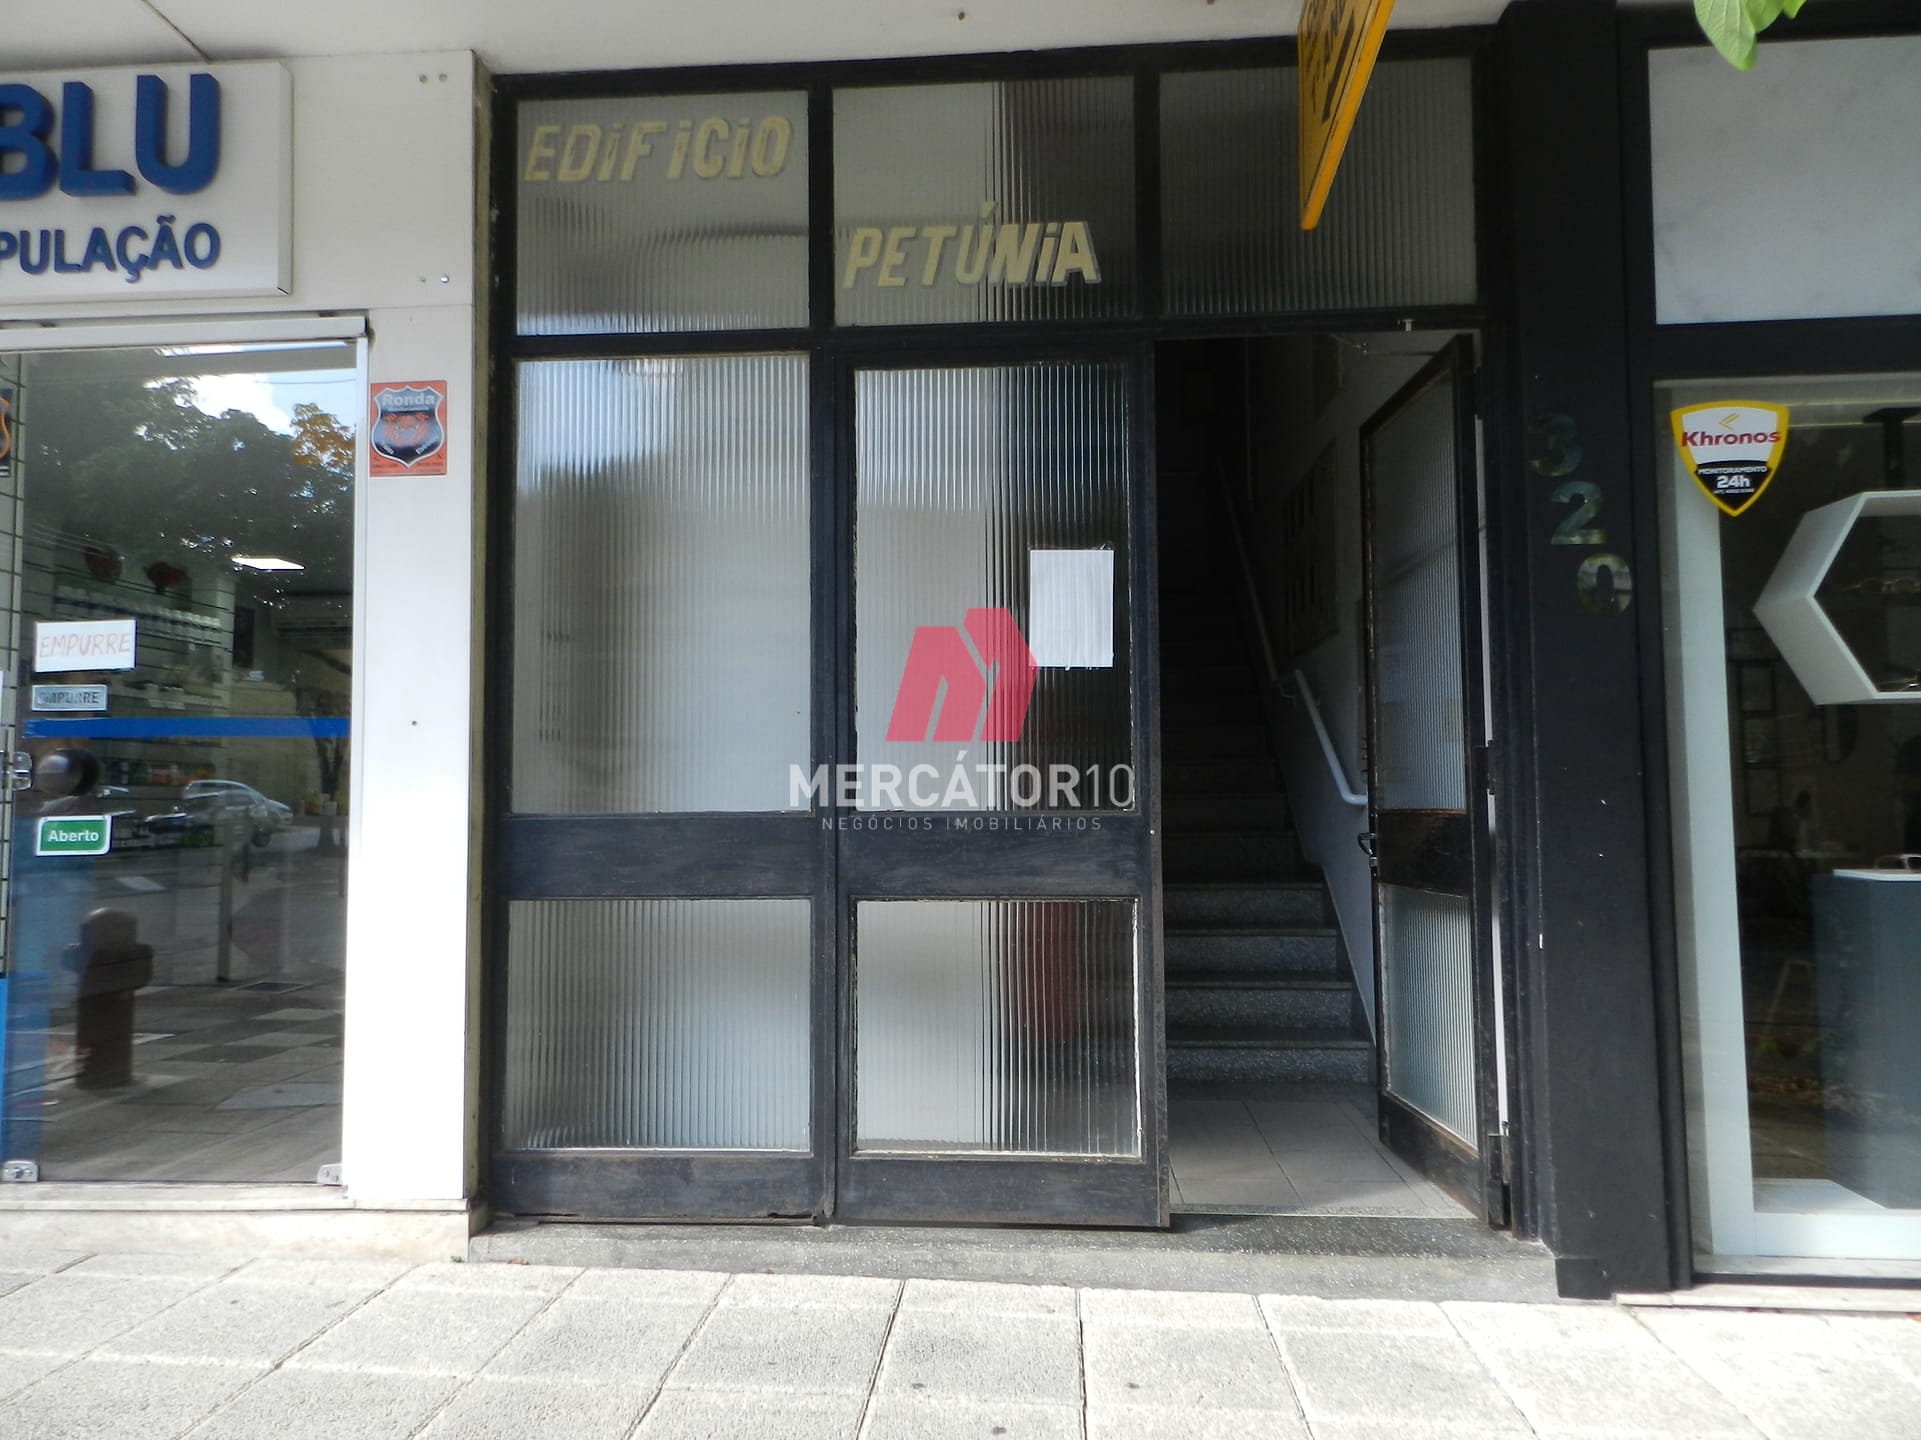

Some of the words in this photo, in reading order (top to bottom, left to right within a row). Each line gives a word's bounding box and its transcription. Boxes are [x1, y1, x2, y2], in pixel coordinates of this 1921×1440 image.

[0, 74, 220, 200] BLU
[382, 392, 435, 406] Ronda
[1681, 431, 1782, 447] Khronos
[1717, 475, 1751, 489] 24h
[40, 633, 131, 658] EMPURRE
[47, 830, 100, 843] Aberto
